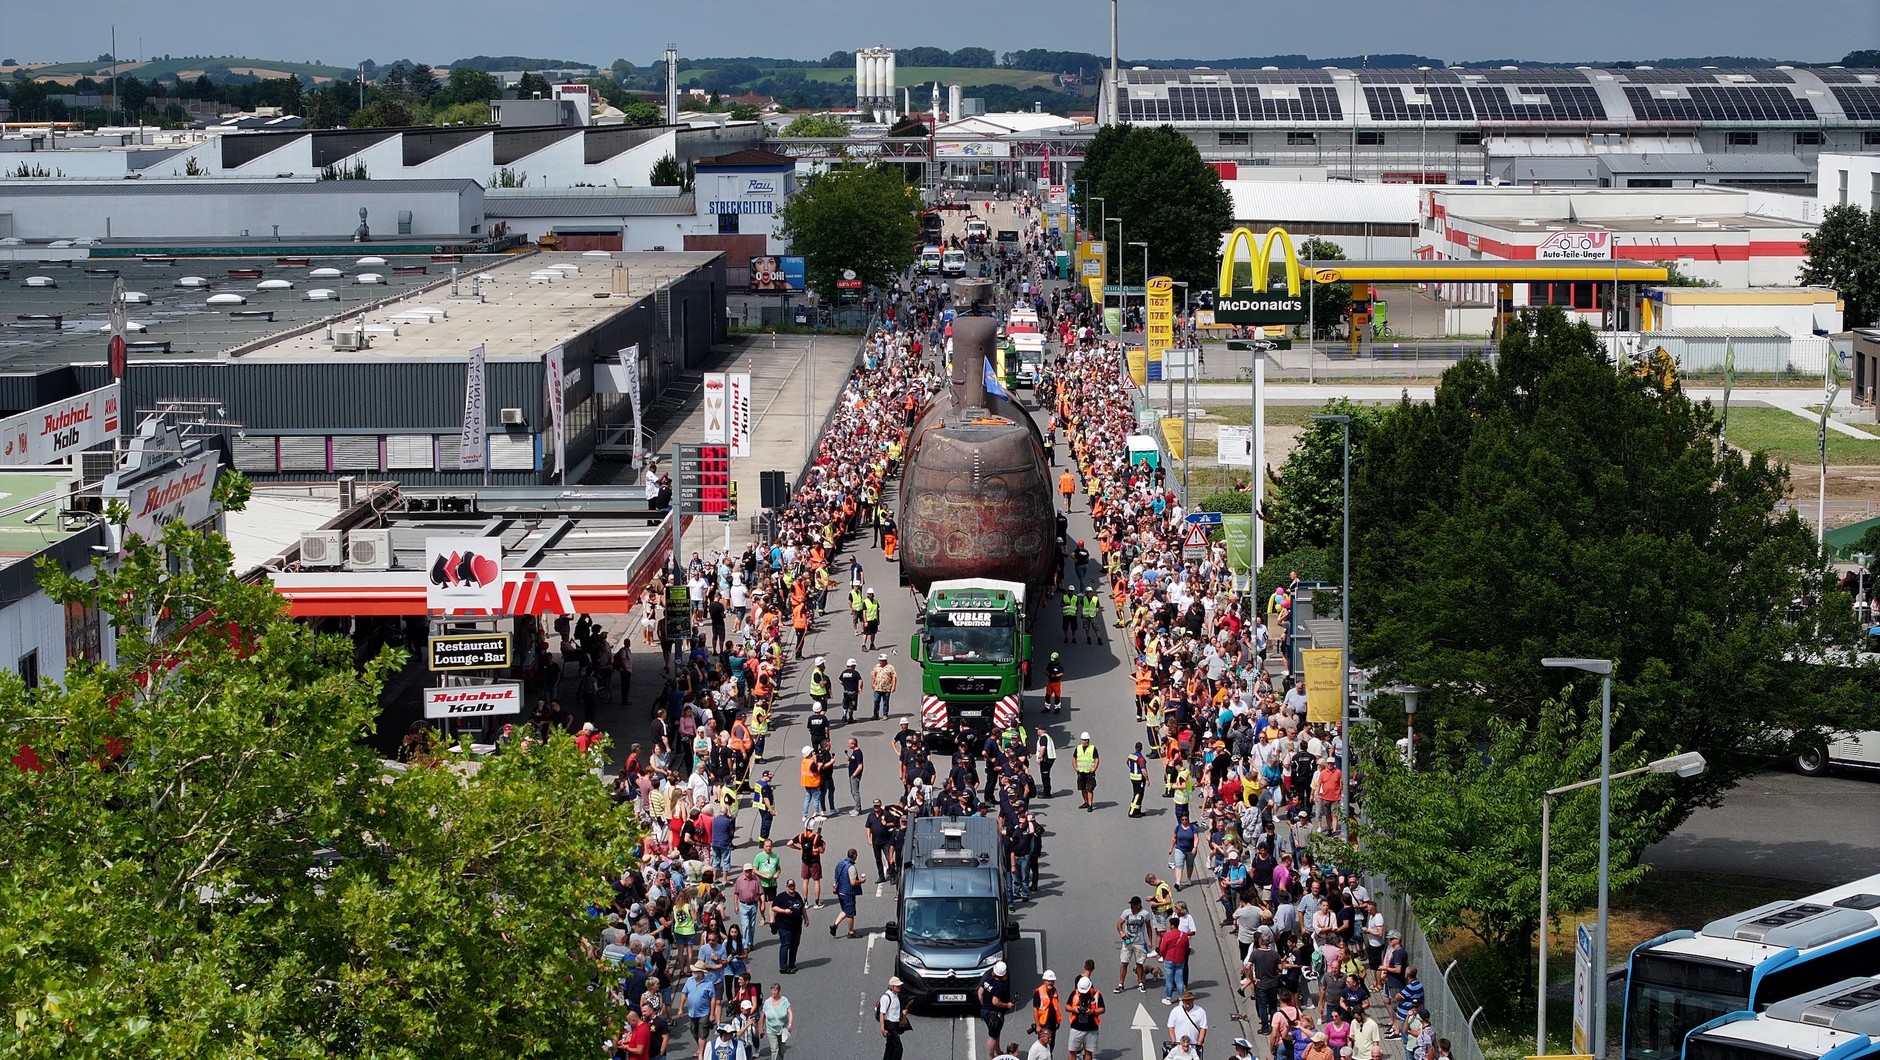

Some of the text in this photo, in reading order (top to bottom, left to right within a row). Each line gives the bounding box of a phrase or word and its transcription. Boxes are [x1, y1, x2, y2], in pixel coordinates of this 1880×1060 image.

[747, 179, 774, 193] Rau
[709, 201, 773, 214] STRECKGITTER
[1543, 250, 1605, 260] Auto-Teile-Unger
[1320, 273, 1337, 281] JET
[1150, 280, 1170, 289] JET
[1218, 300, 1302, 311] McDonald's
[104, 395, 118, 415] AVIA
[41, 402, 92, 436] Autohof
[53, 427, 79, 452] Kolb
[137, 463, 207, 519] Autohof
[435, 640, 504, 652] Restaurant
[428, 690, 517, 704] Autohof
[448, 703, 495, 713] Kolb
